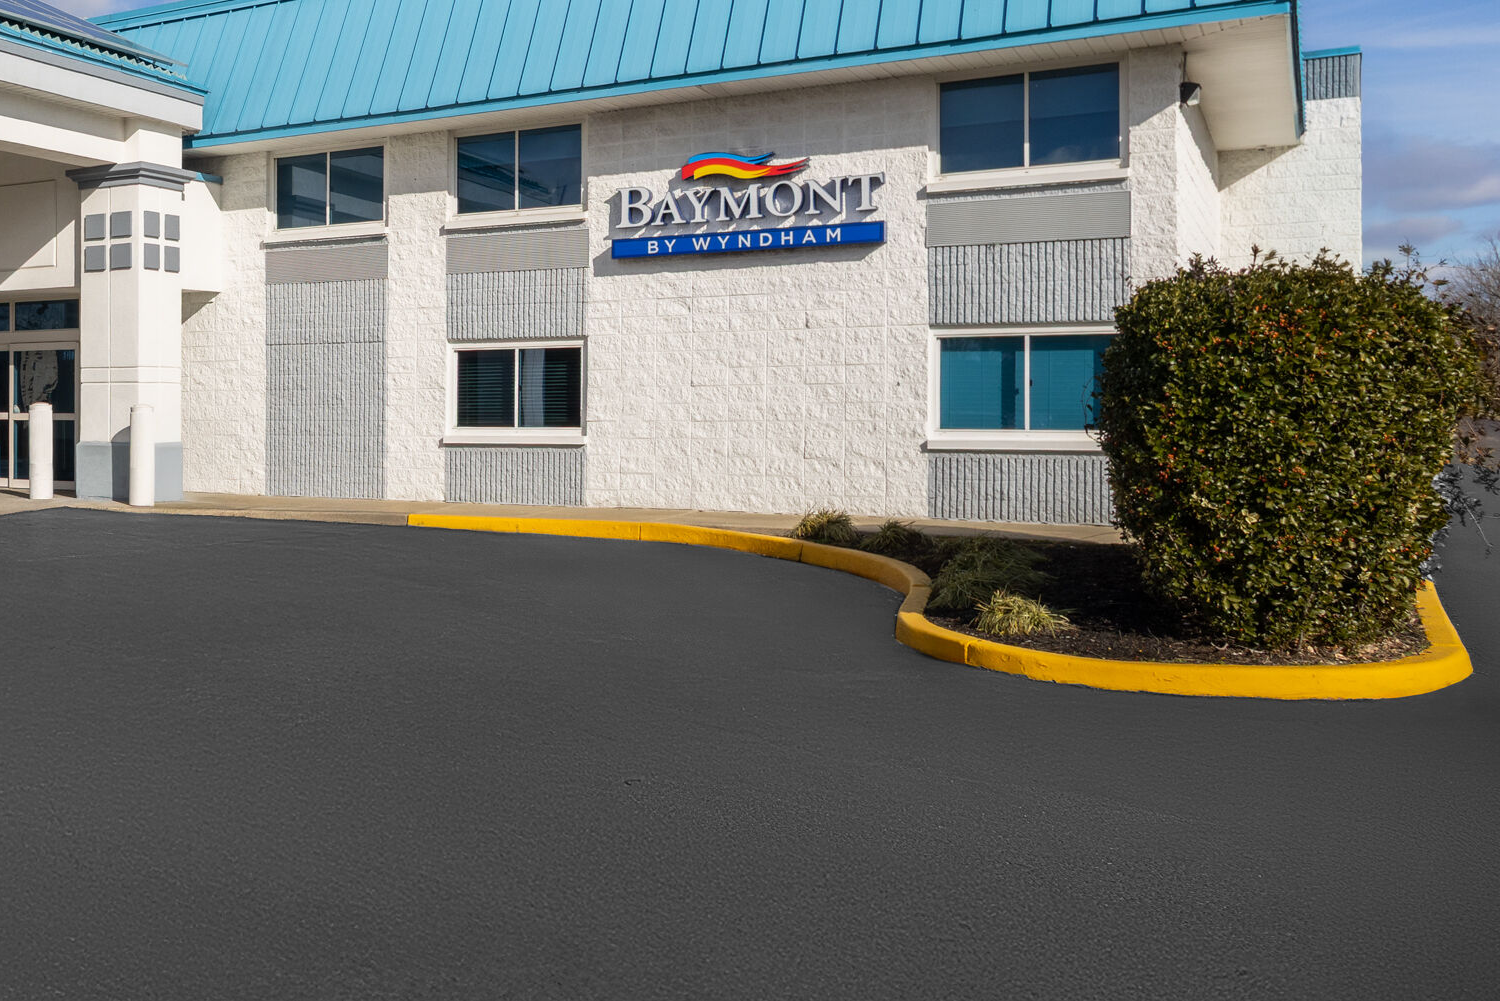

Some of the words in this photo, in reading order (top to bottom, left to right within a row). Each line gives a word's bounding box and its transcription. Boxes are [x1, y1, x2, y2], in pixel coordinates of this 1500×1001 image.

[615, 172, 885, 229] BAYMONT
[647, 239, 677, 255] BY
[692, 228, 842, 251] WYNDHAM
